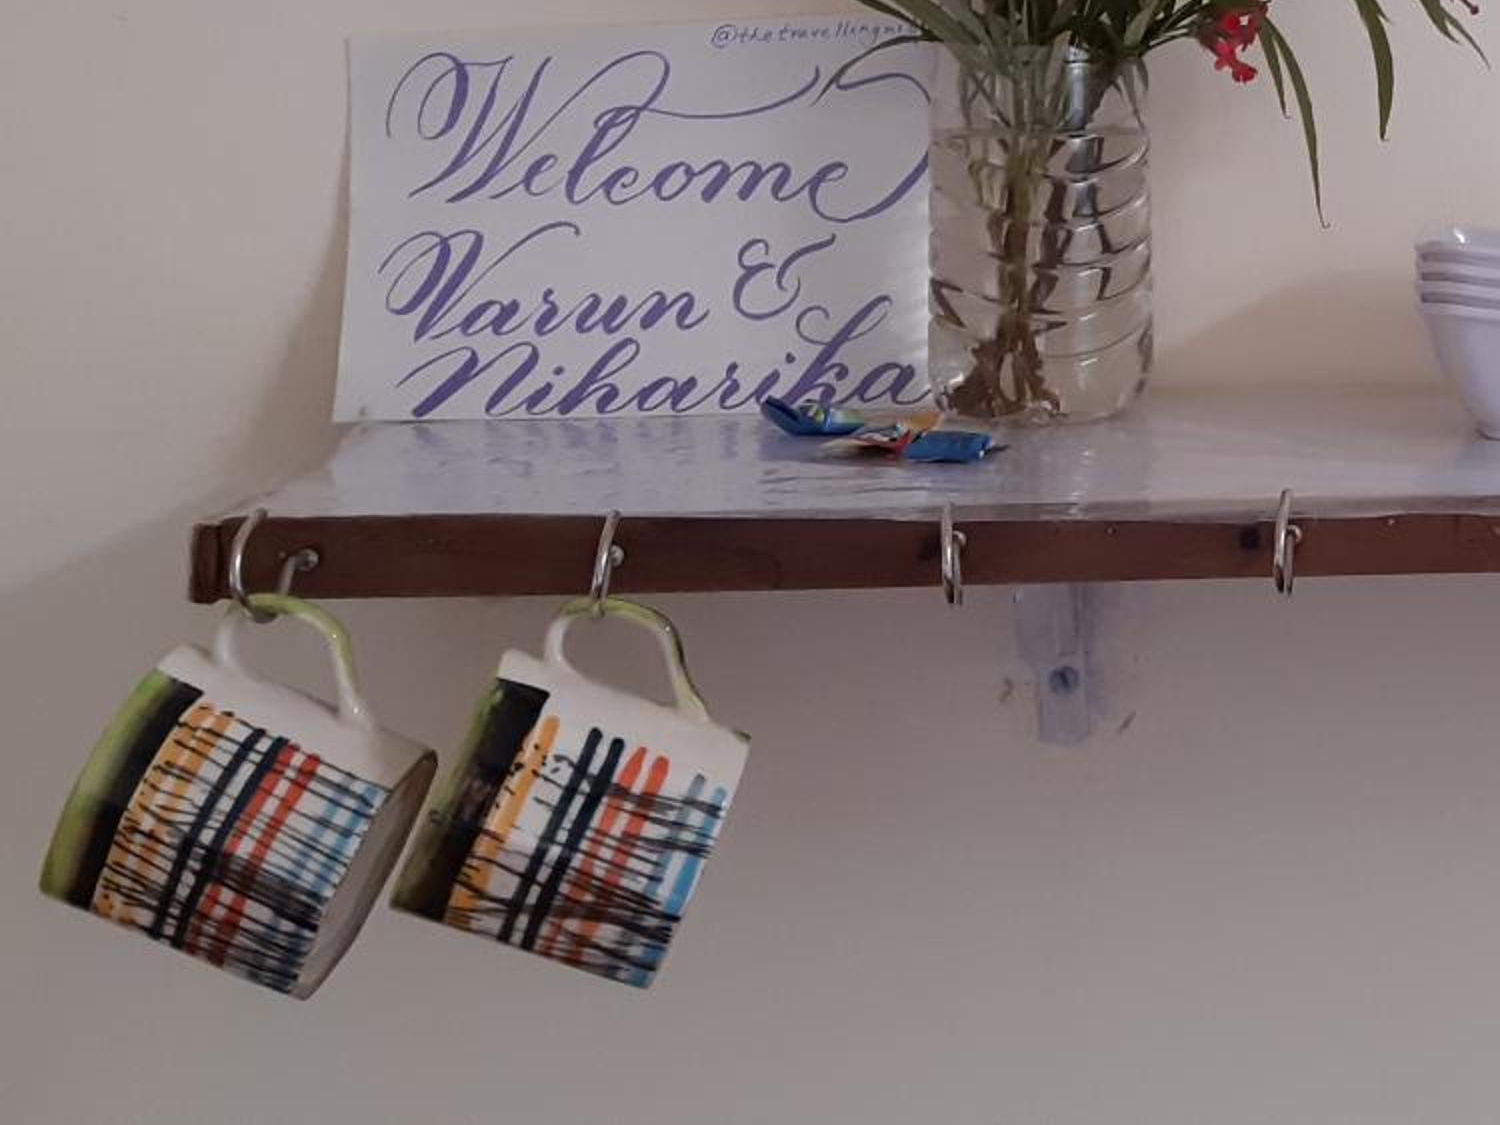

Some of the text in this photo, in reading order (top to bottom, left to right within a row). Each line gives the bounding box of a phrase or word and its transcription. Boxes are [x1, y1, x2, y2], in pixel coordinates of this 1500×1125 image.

[386, 50, 932, 223] Welcome
[378, 221, 837, 343] Varun &
[395, 295, 932, 418] Niharika
